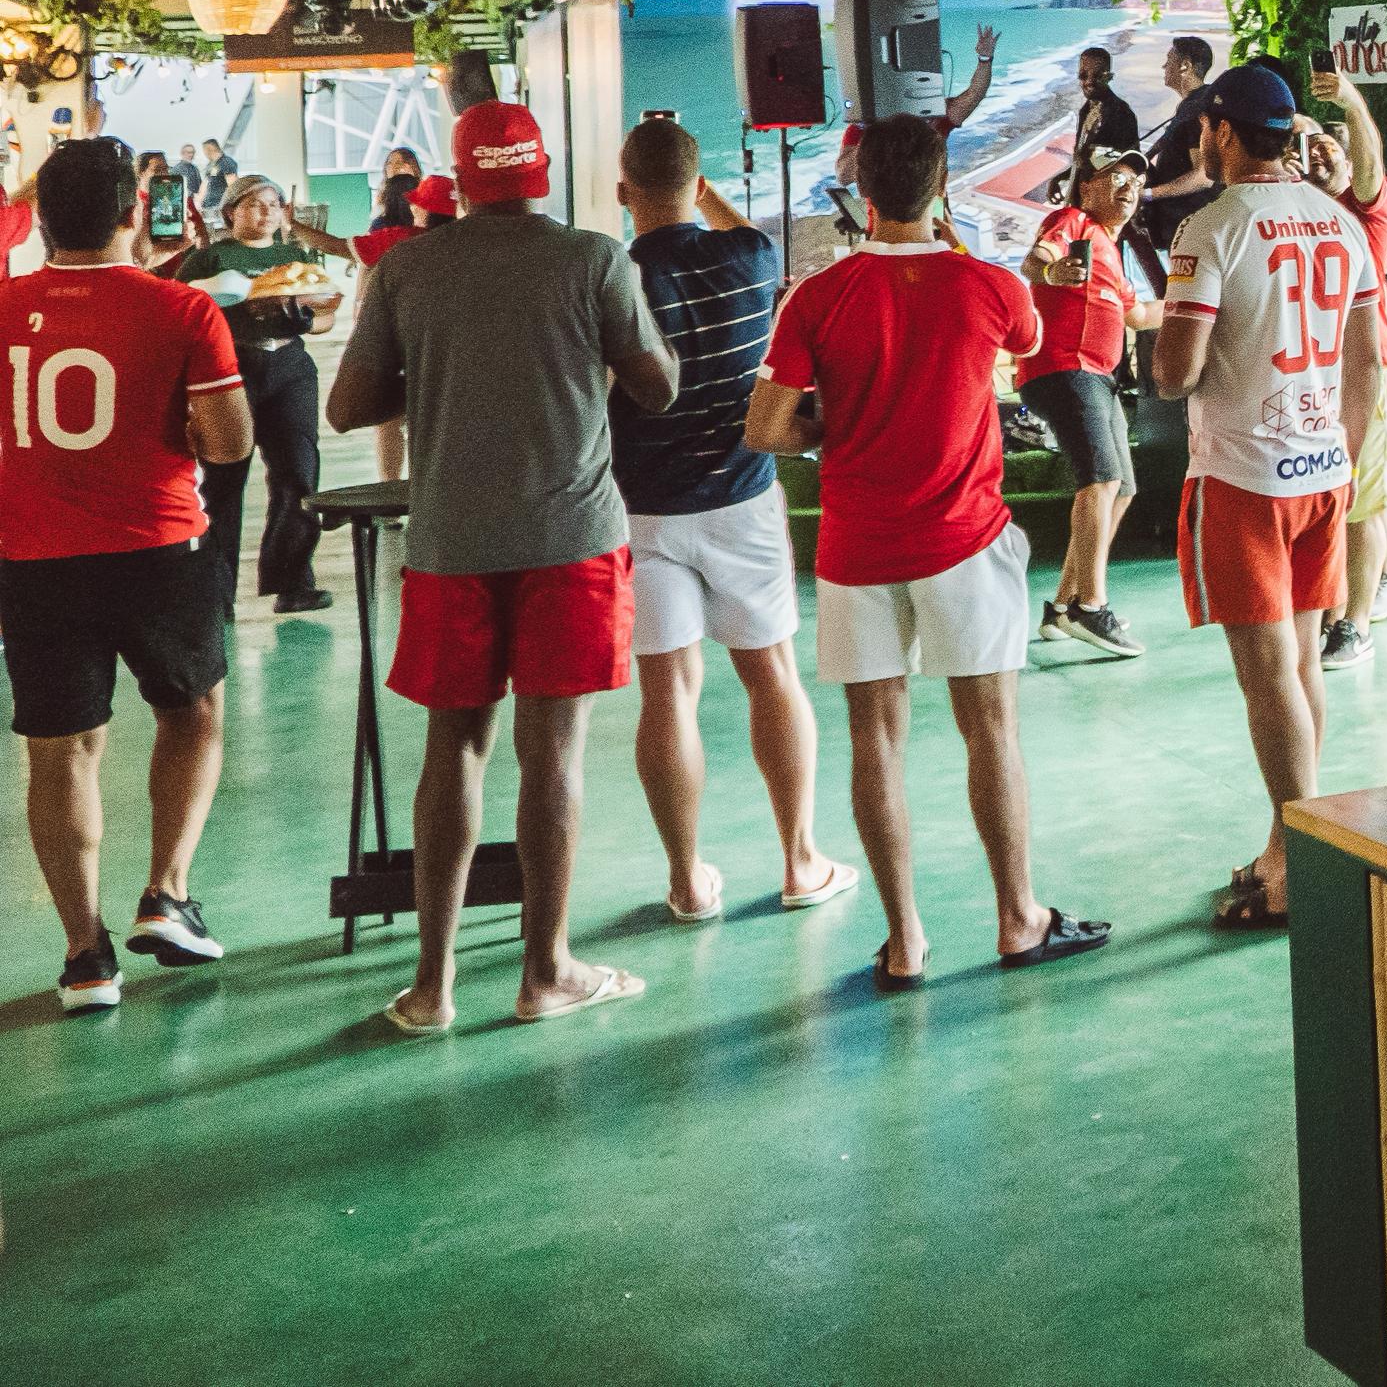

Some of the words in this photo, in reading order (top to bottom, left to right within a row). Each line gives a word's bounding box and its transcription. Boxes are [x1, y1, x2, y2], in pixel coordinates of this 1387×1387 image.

[1256, 216, 1343, 241] Unimed
[1267, 241, 1350, 375] 39
[9, 345, 116, 450] 10
